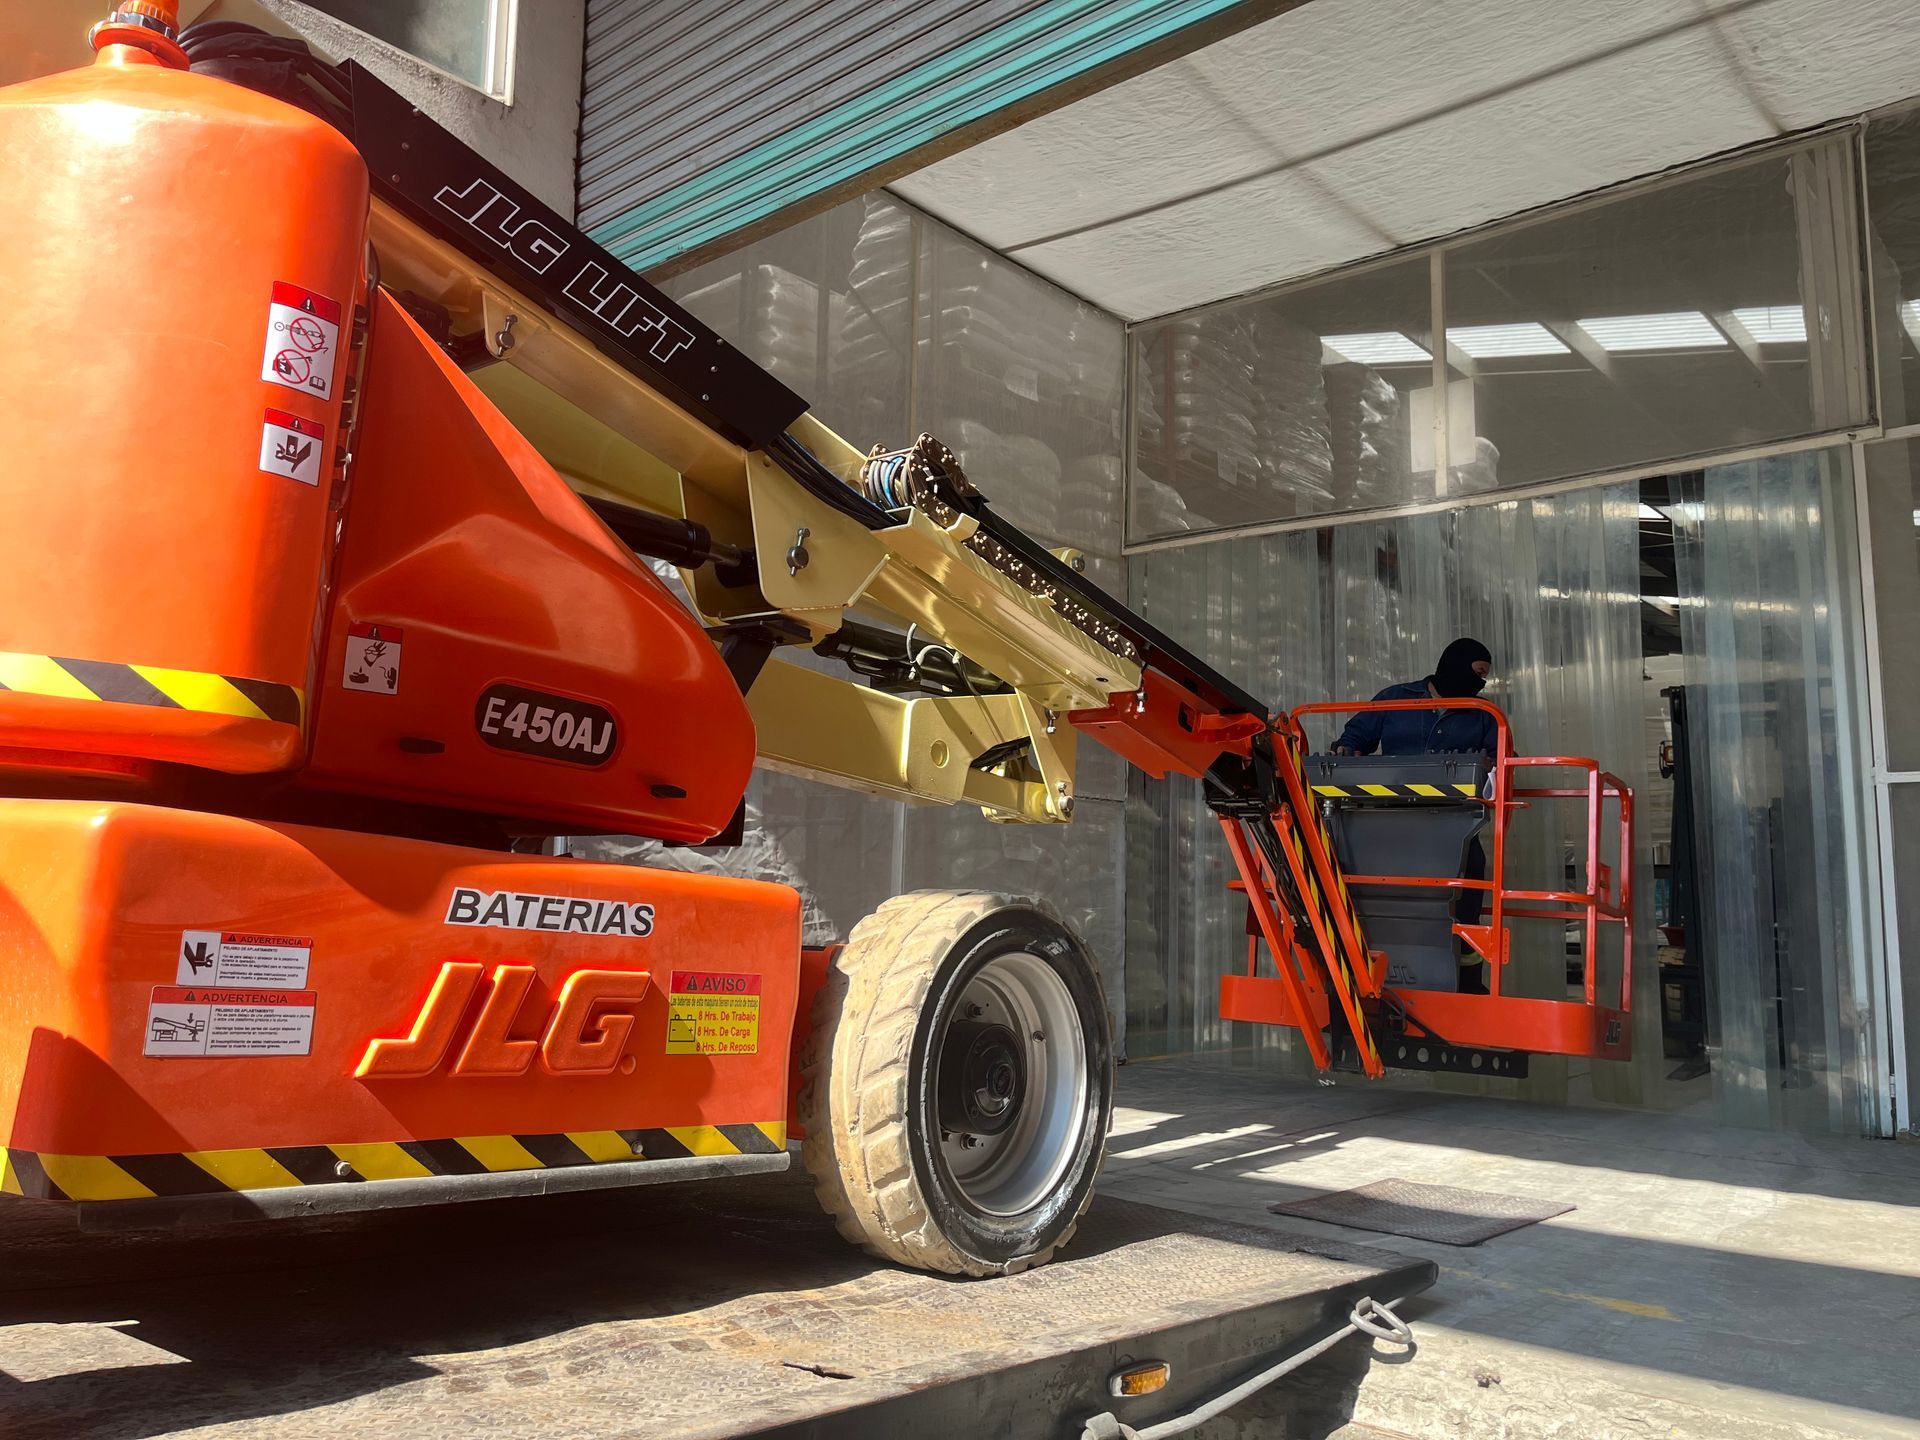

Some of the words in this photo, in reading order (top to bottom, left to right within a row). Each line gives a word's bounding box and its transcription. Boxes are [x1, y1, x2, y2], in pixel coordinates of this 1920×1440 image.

[432, 177, 571, 276] JLG
[561, 260, 697, 364] LIFT
[481, 696, 613, 755] E450AJ
[447, 889, 655, 936] BATERIAS
[240, 936, 303, 946] ADVERTENCIA
[702, 977, 747, 992] AVISO
[202, 993, 288, 1004] ADVERTENCIA
[720, 1011, 730, 1021] De
[732, 1011, 757, 1023] Trabajo
[719, 1026, 729, 1037] De
[730, 1026, 751, 1039] Carga
[718, 1041, 728, 1052] De
[729, 1041, 756, 1054] Reposo
